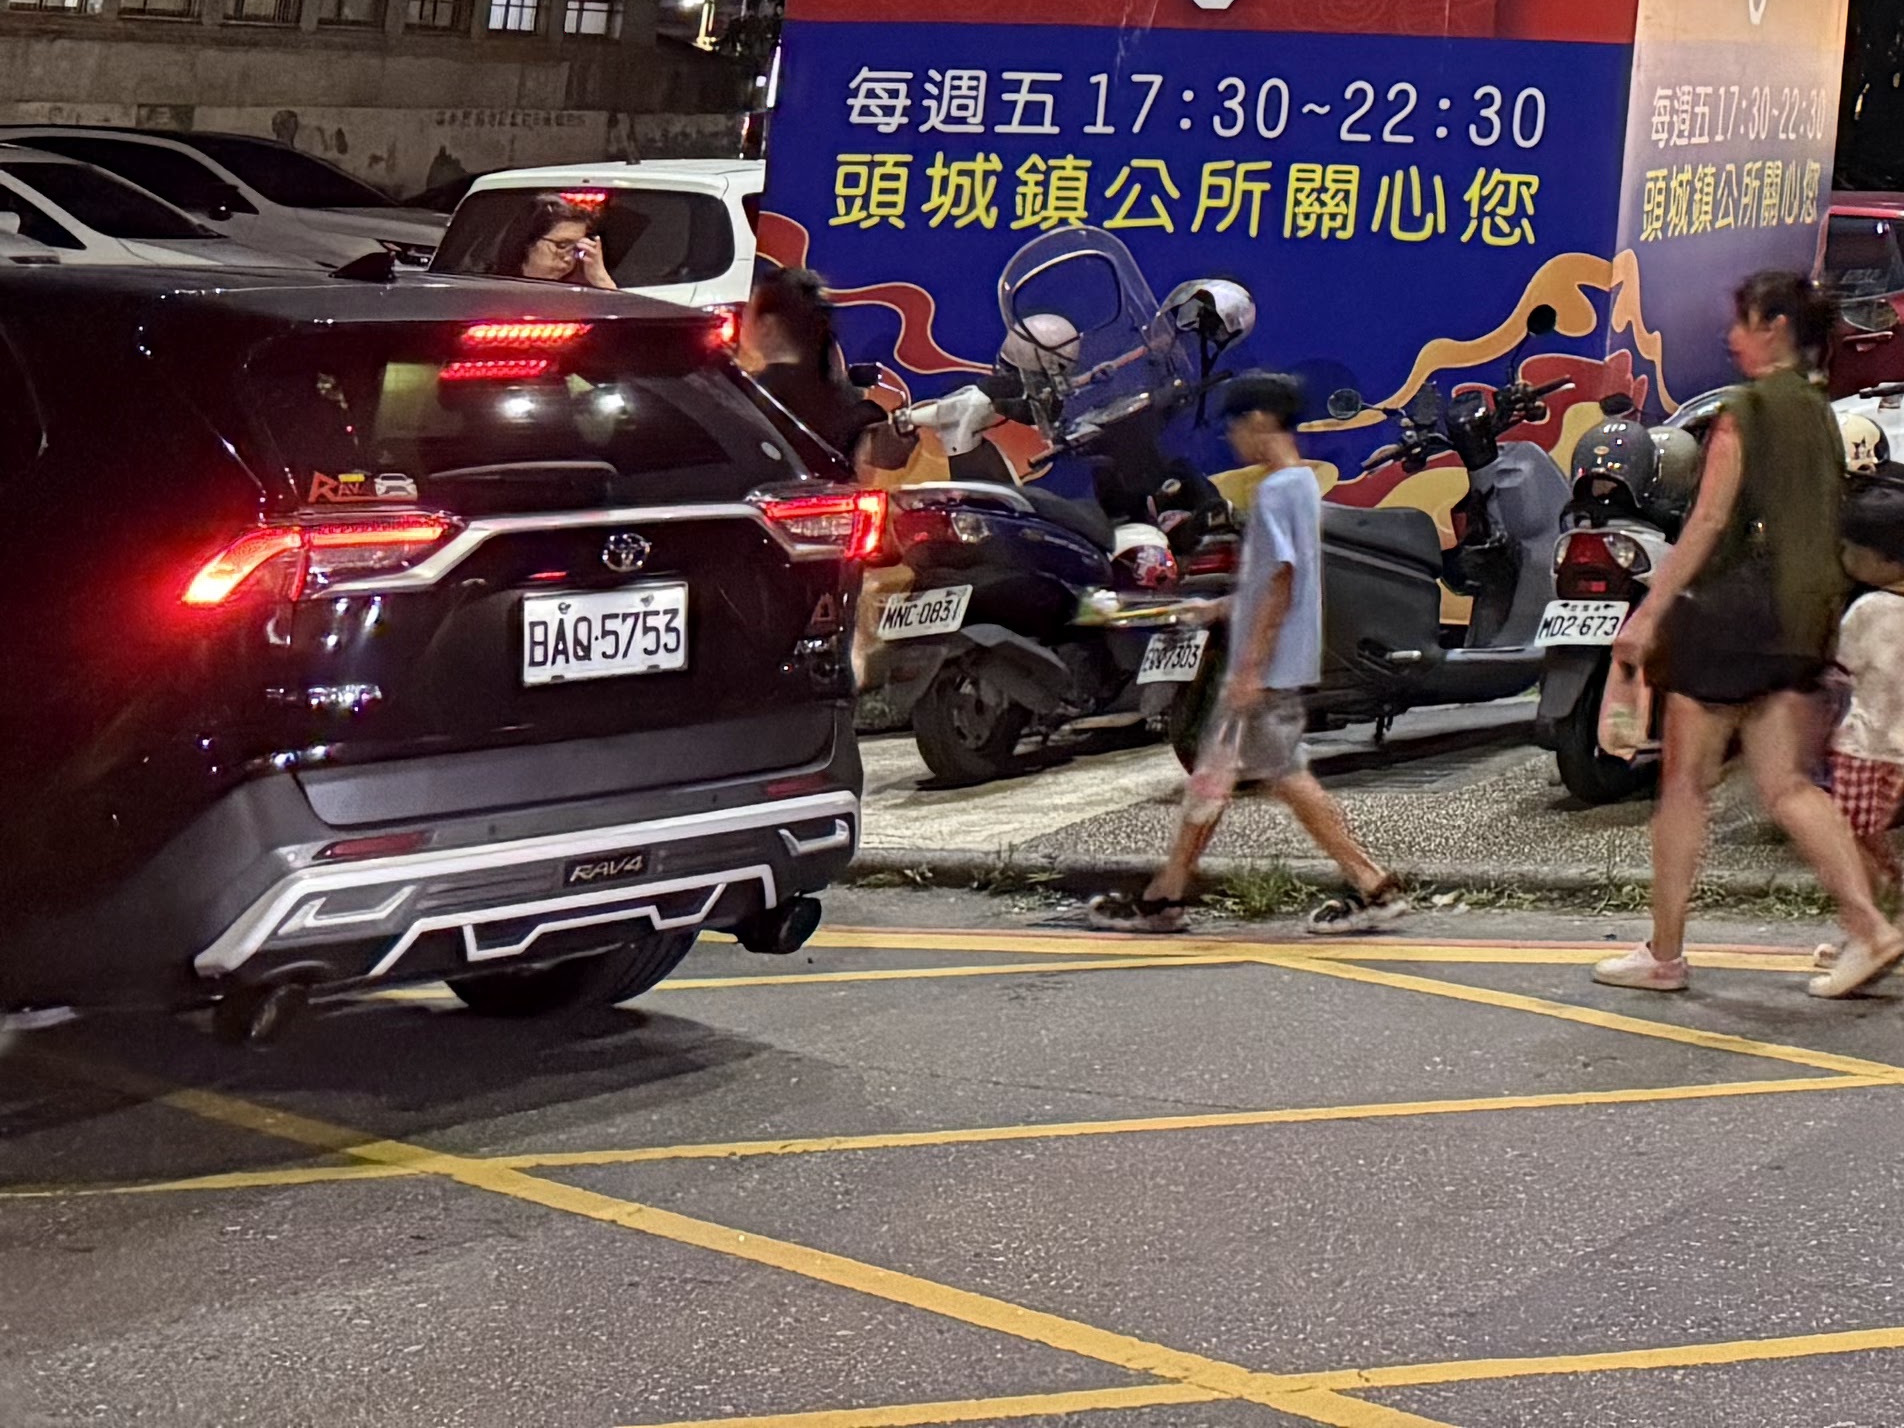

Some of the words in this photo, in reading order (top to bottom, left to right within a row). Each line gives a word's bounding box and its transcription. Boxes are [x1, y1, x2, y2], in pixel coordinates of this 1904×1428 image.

[828, 151, 1540, 247] 頭城鎮公所關心您
[1640, 158, 1821, 242] 頭城鎮公所關心您
[569, 855, 643, 883] RAV4
